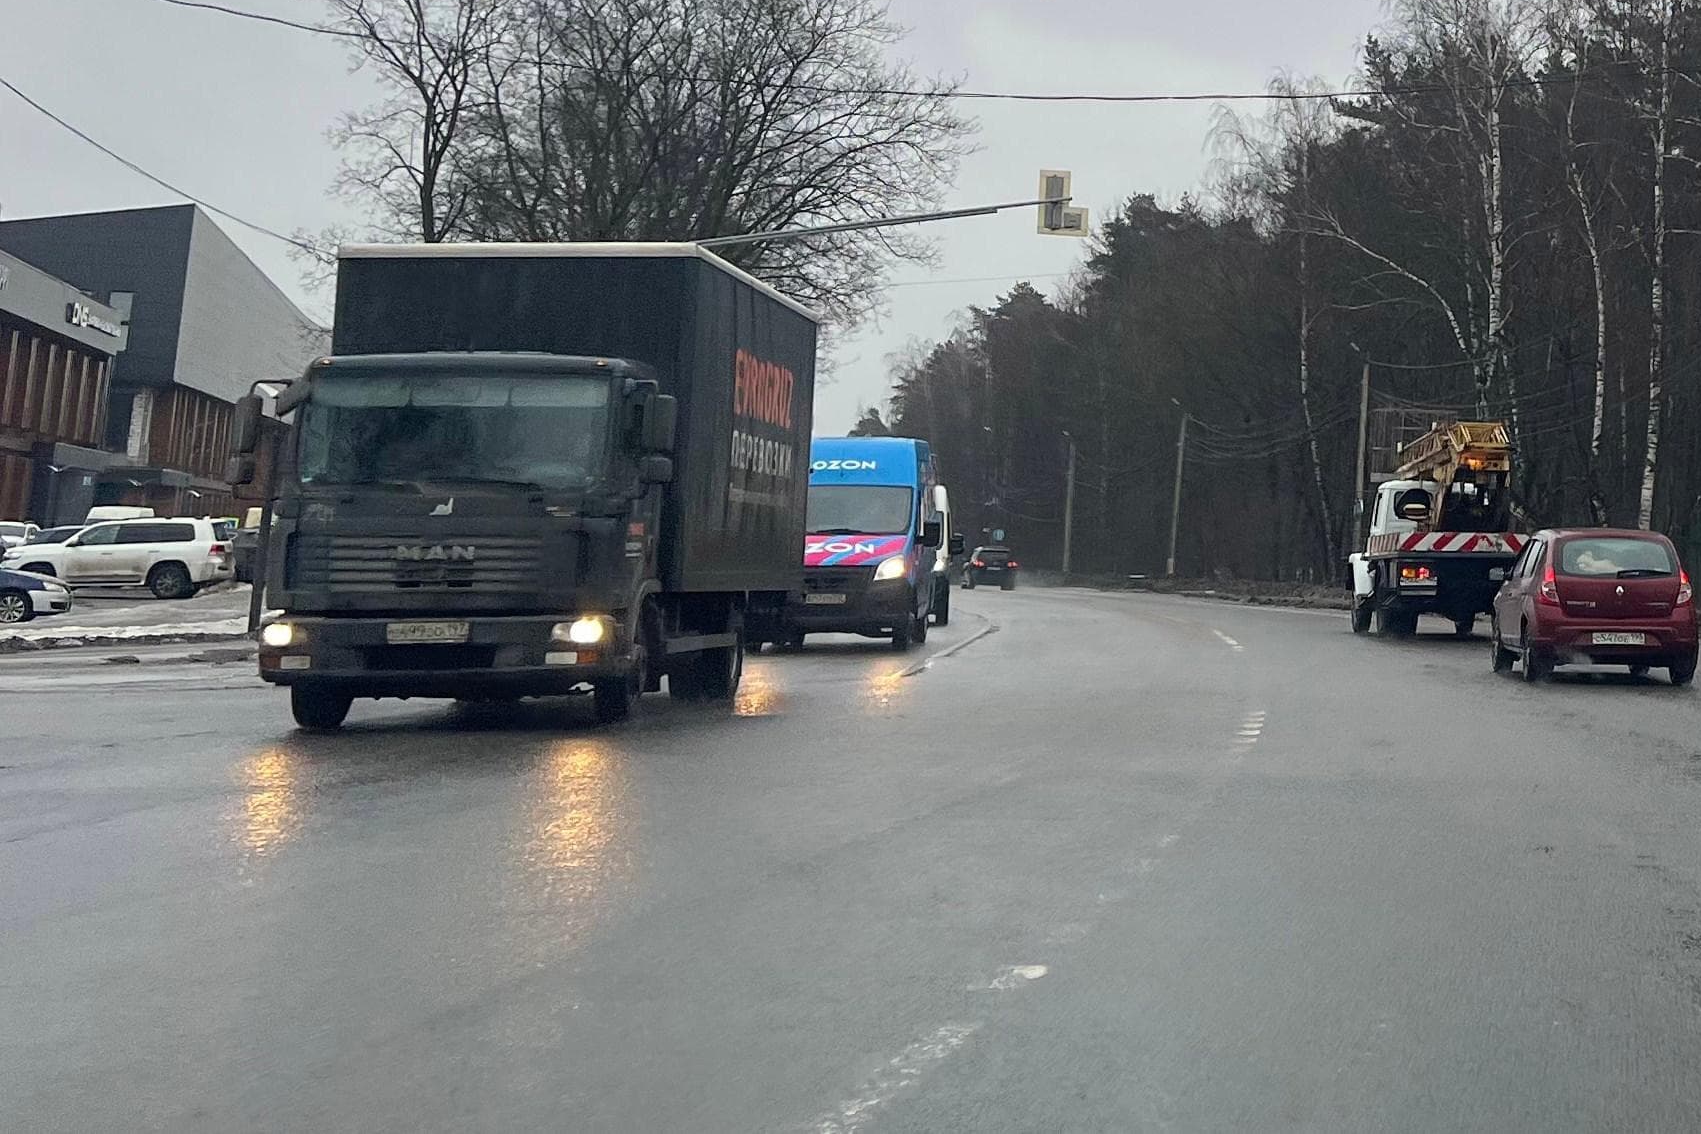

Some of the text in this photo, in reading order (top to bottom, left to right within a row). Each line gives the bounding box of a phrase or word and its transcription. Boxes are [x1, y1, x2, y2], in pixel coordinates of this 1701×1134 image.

[731, 429, 792, 477] ПЕРЕВОЗКИ
[812, 460, 876, 470] OZON
[397, 546, 475, 560] MAN
[804, 542, 875, 554] ZON
